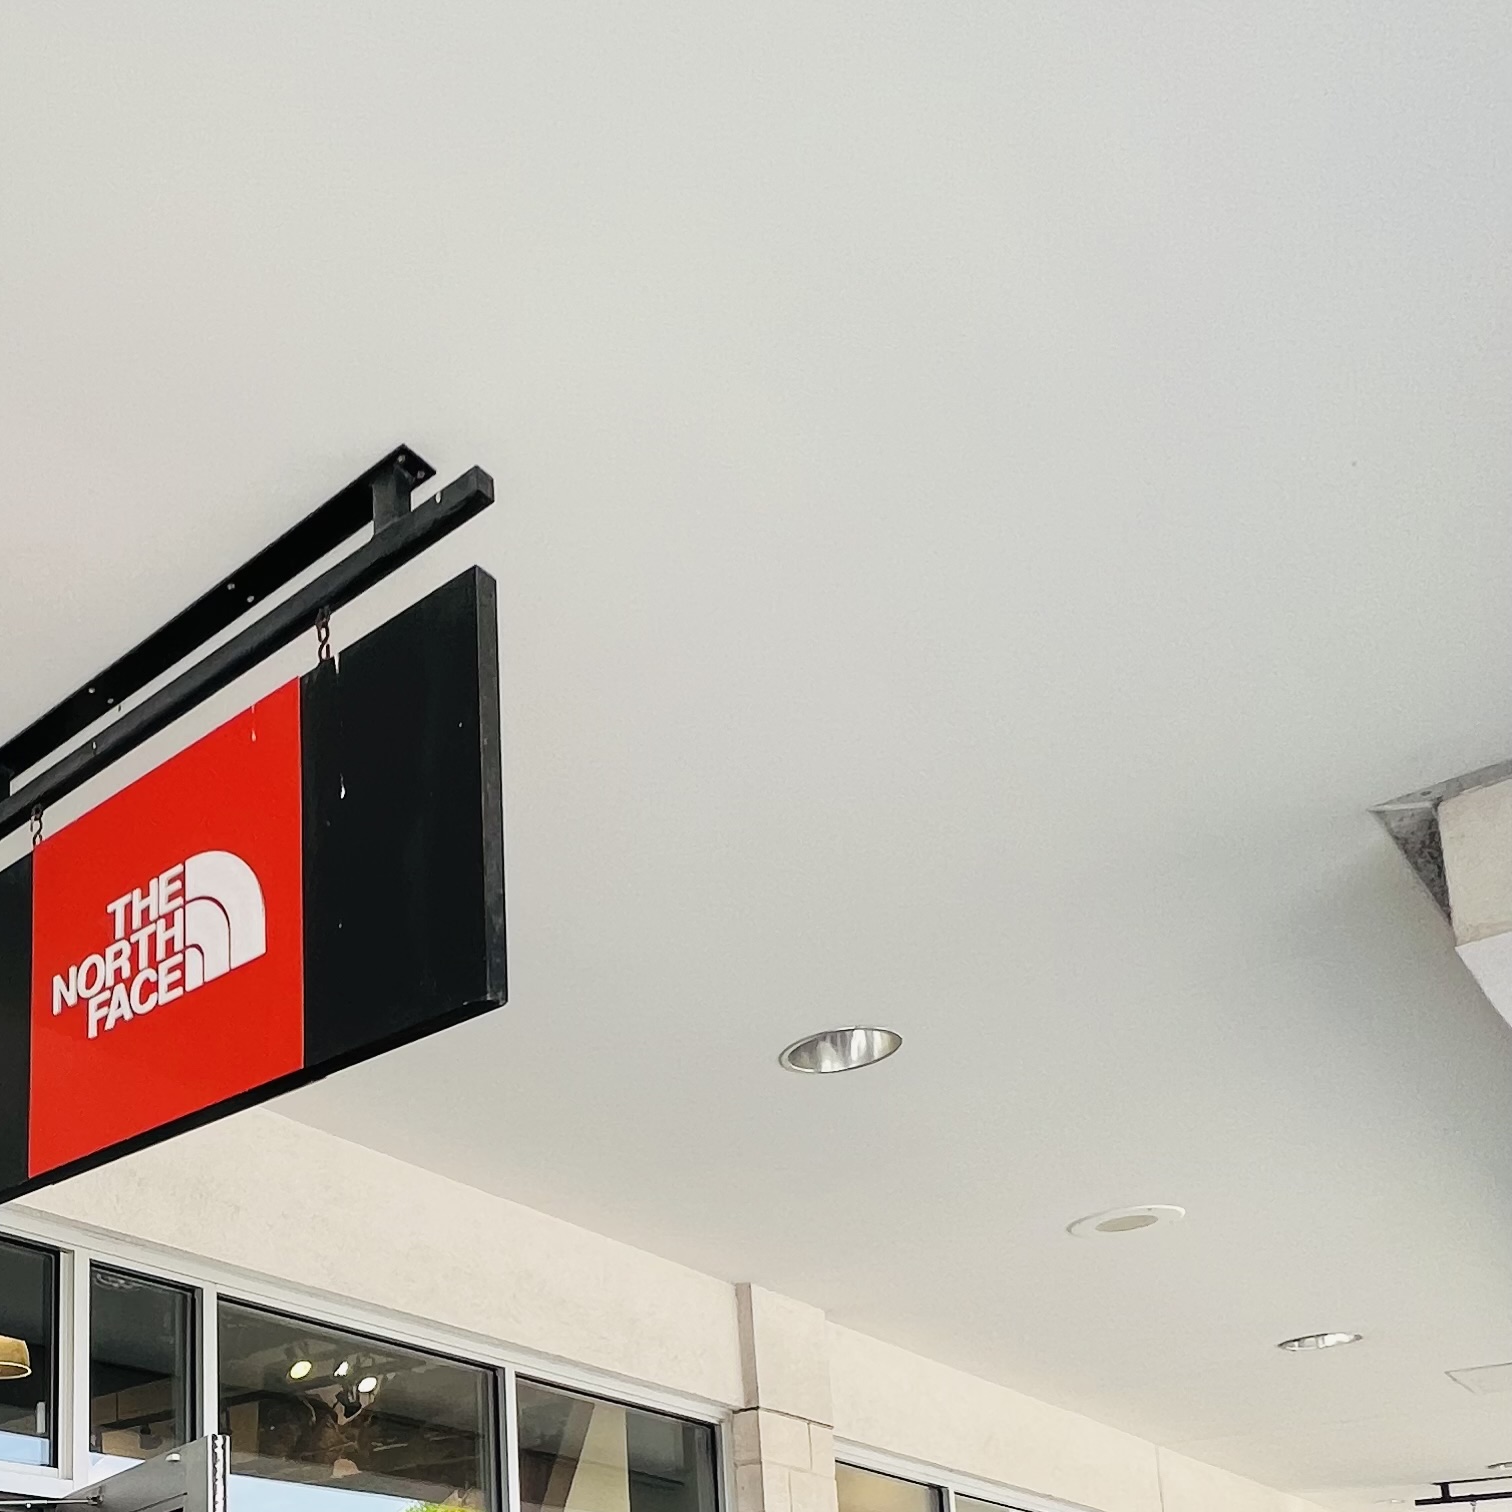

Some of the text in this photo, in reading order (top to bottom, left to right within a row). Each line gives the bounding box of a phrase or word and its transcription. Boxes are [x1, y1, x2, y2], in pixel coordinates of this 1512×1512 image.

[107, 863, 184, 941] THE
[52, 907, 184, 1016] NORTH
[87, 952, 184, 1040] FACE
